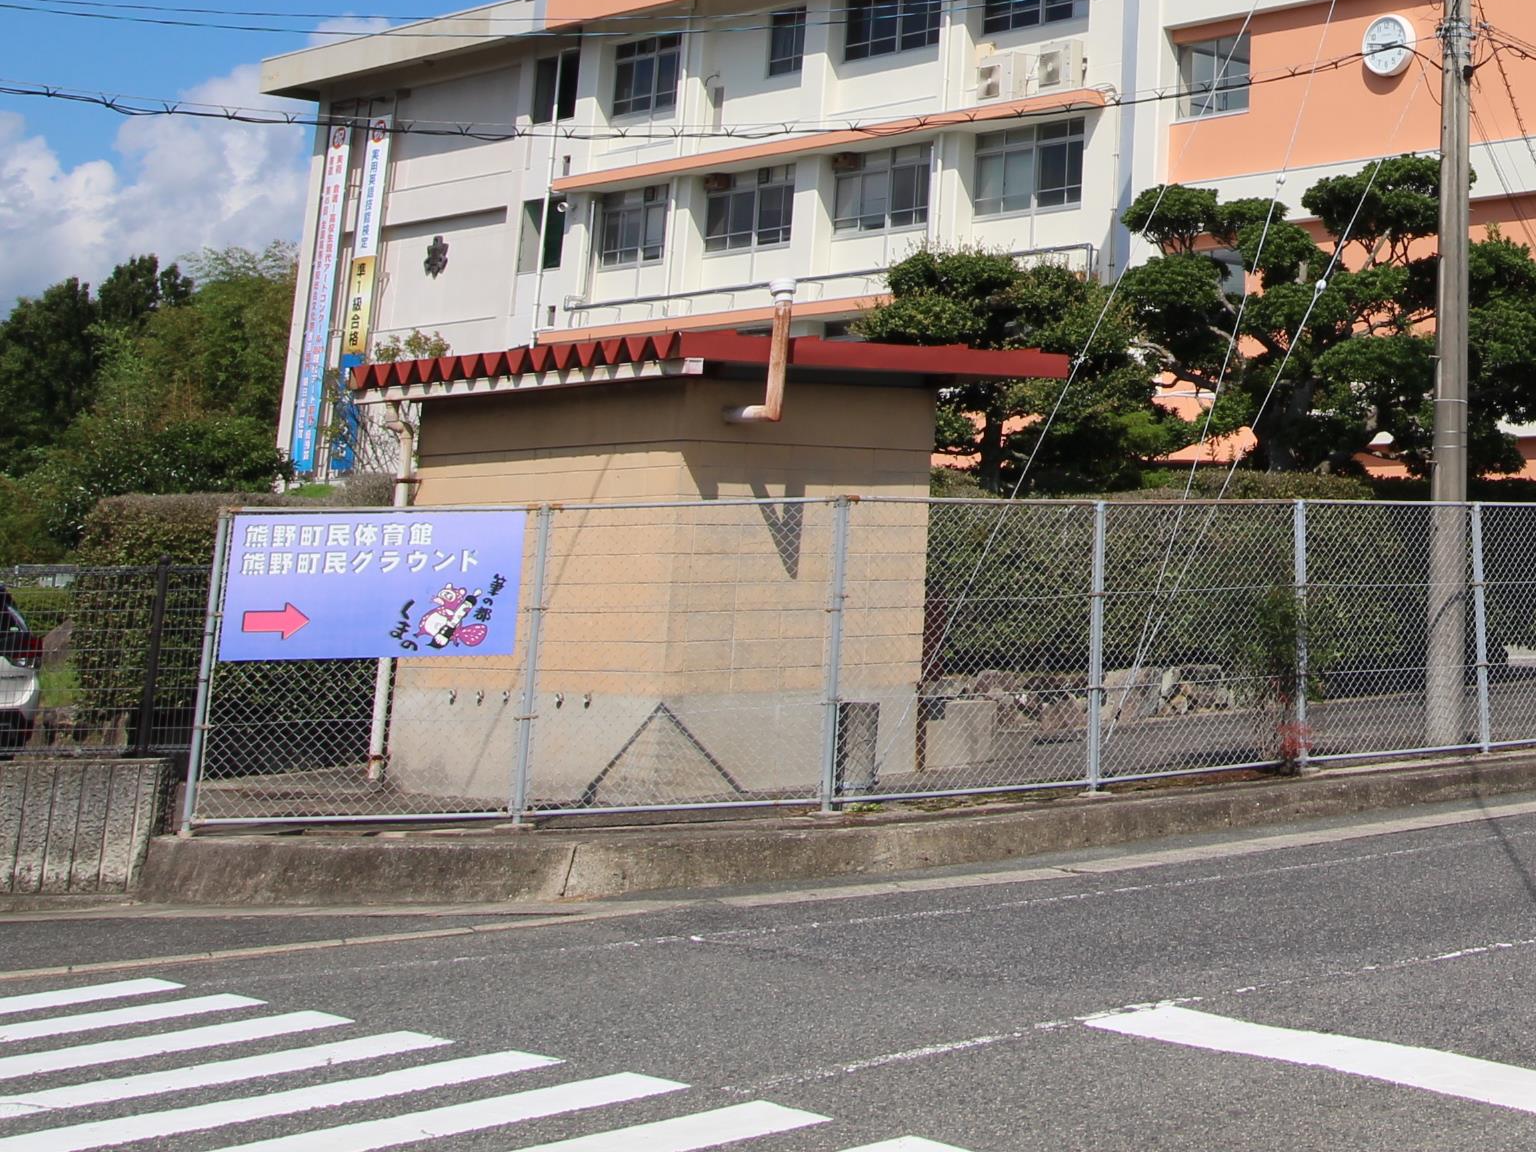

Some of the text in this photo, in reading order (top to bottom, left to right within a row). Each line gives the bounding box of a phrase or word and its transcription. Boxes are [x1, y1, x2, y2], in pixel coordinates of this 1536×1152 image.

[243, 522, 433, 548] 熊野町民体育館
[240, 549, 480, 576] 熊野町民グラウンド
[473, 573, 507, 622] 筆の都
[389, 599, 418, 652] くまの
